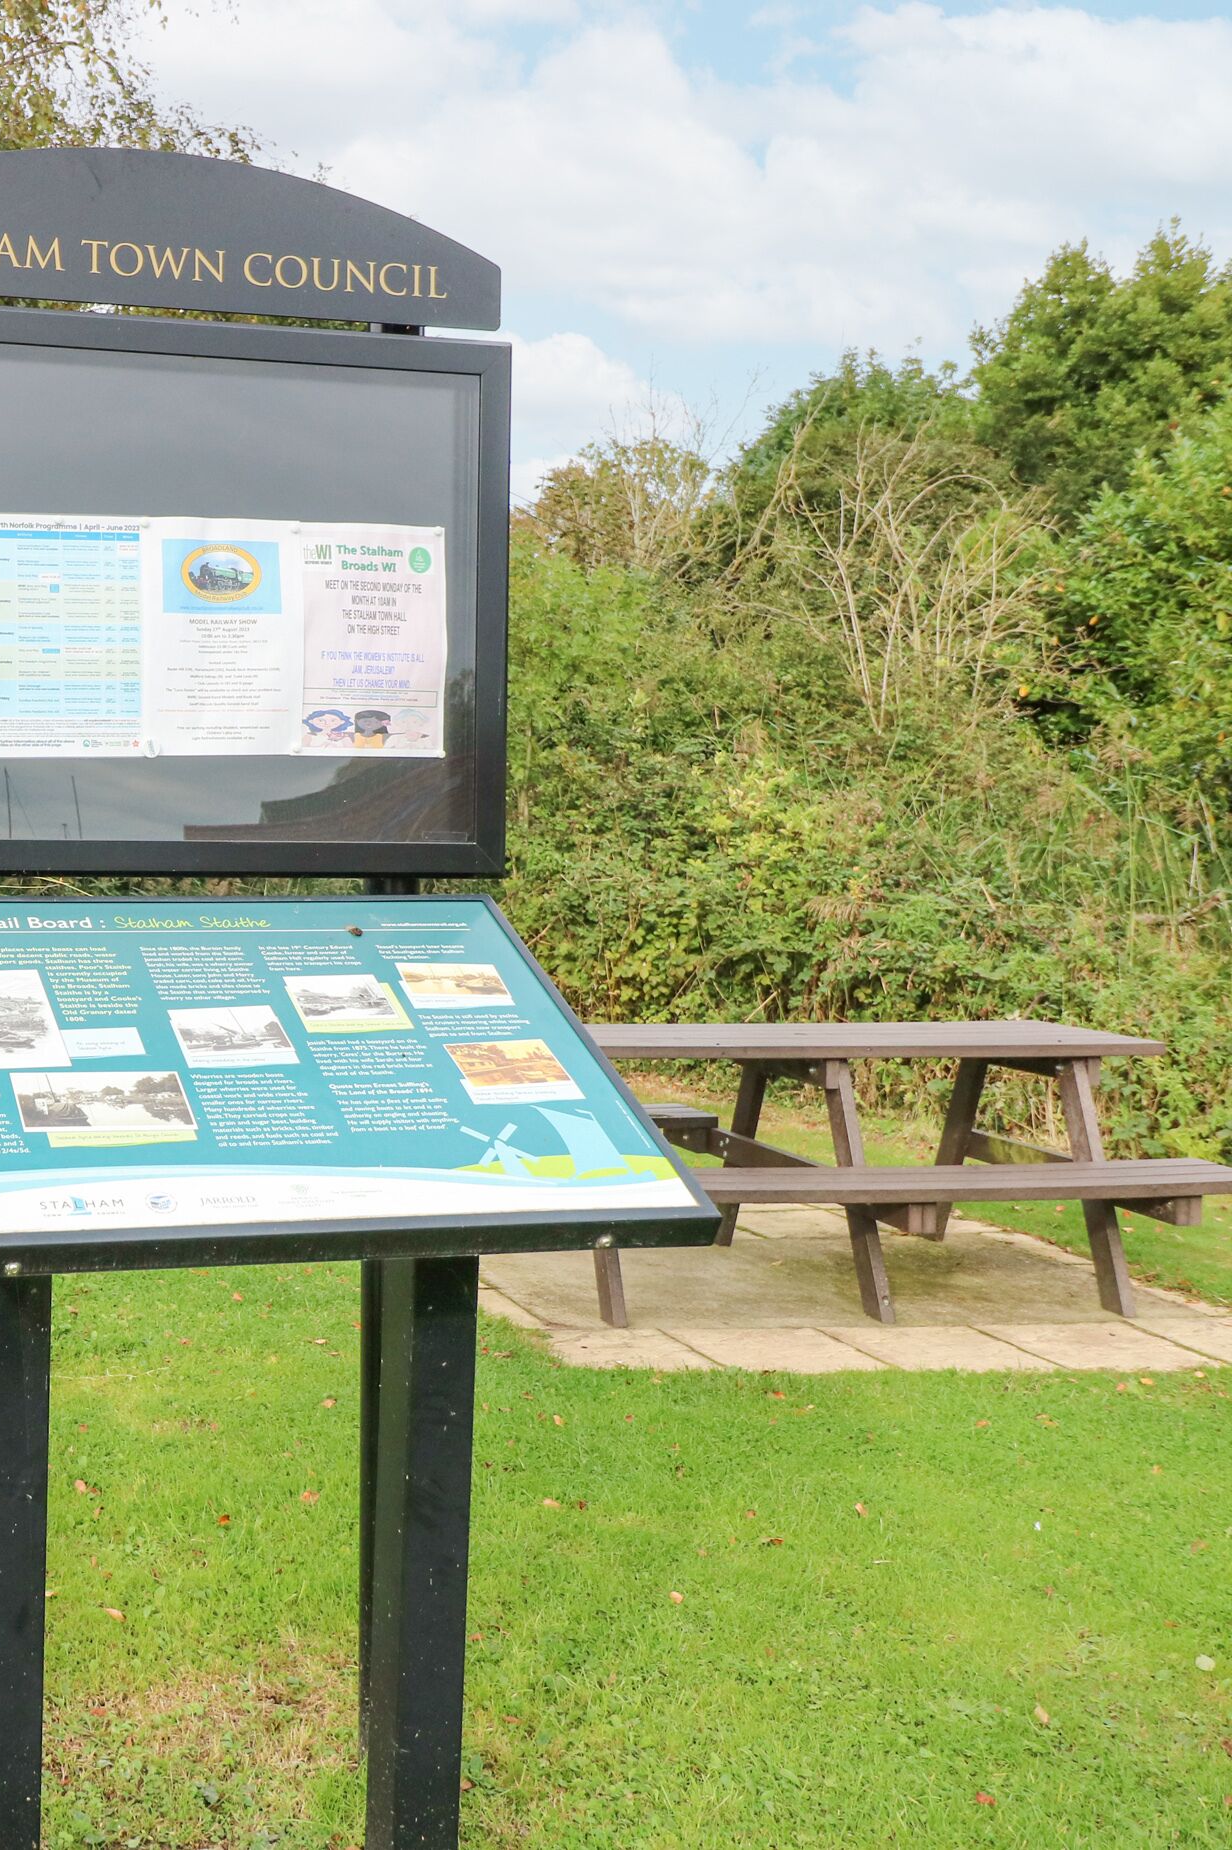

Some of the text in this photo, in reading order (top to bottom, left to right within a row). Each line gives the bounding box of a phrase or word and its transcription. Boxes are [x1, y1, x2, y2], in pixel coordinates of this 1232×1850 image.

[81, 239, 226, 284] TOWN
[244, 253, 448, 298] COUNCIL
[202, 544, 237, 553] BROADLAND
[336, 544, 403, 557] The Stalham
[341, 561, 396, 572] Broads WI
[325, 580, 422, 593] MEET ON THE SECOND MONDAY OF THE
[352, 595, 396, 606] MONTH AT 10AM IN
[342, 609, 407, 622] THE STALHAM TOWN HALL
[348, 624, 400, 635] ON THE HIGH STREET
[321, 651, 424, 662] IF YOU THINK THE WOMEN'S INSTITUTE IS ALL
[333, 678, 346, 688] THEN
[347, 679, 355, 688] LET
[357, 679, 363, 688] US
[364, 679, 384, 688] CHANGE
[385, 680, 398, 688] YOUR
[27, 917, 92, 928] Board
[114, 916, 193, 929] Stalham
[200, 916, 270, 929] Staithe
[40, 1198, 124, 1210] STALHAM
[200, 1195, 256, 1206] JARROLD
